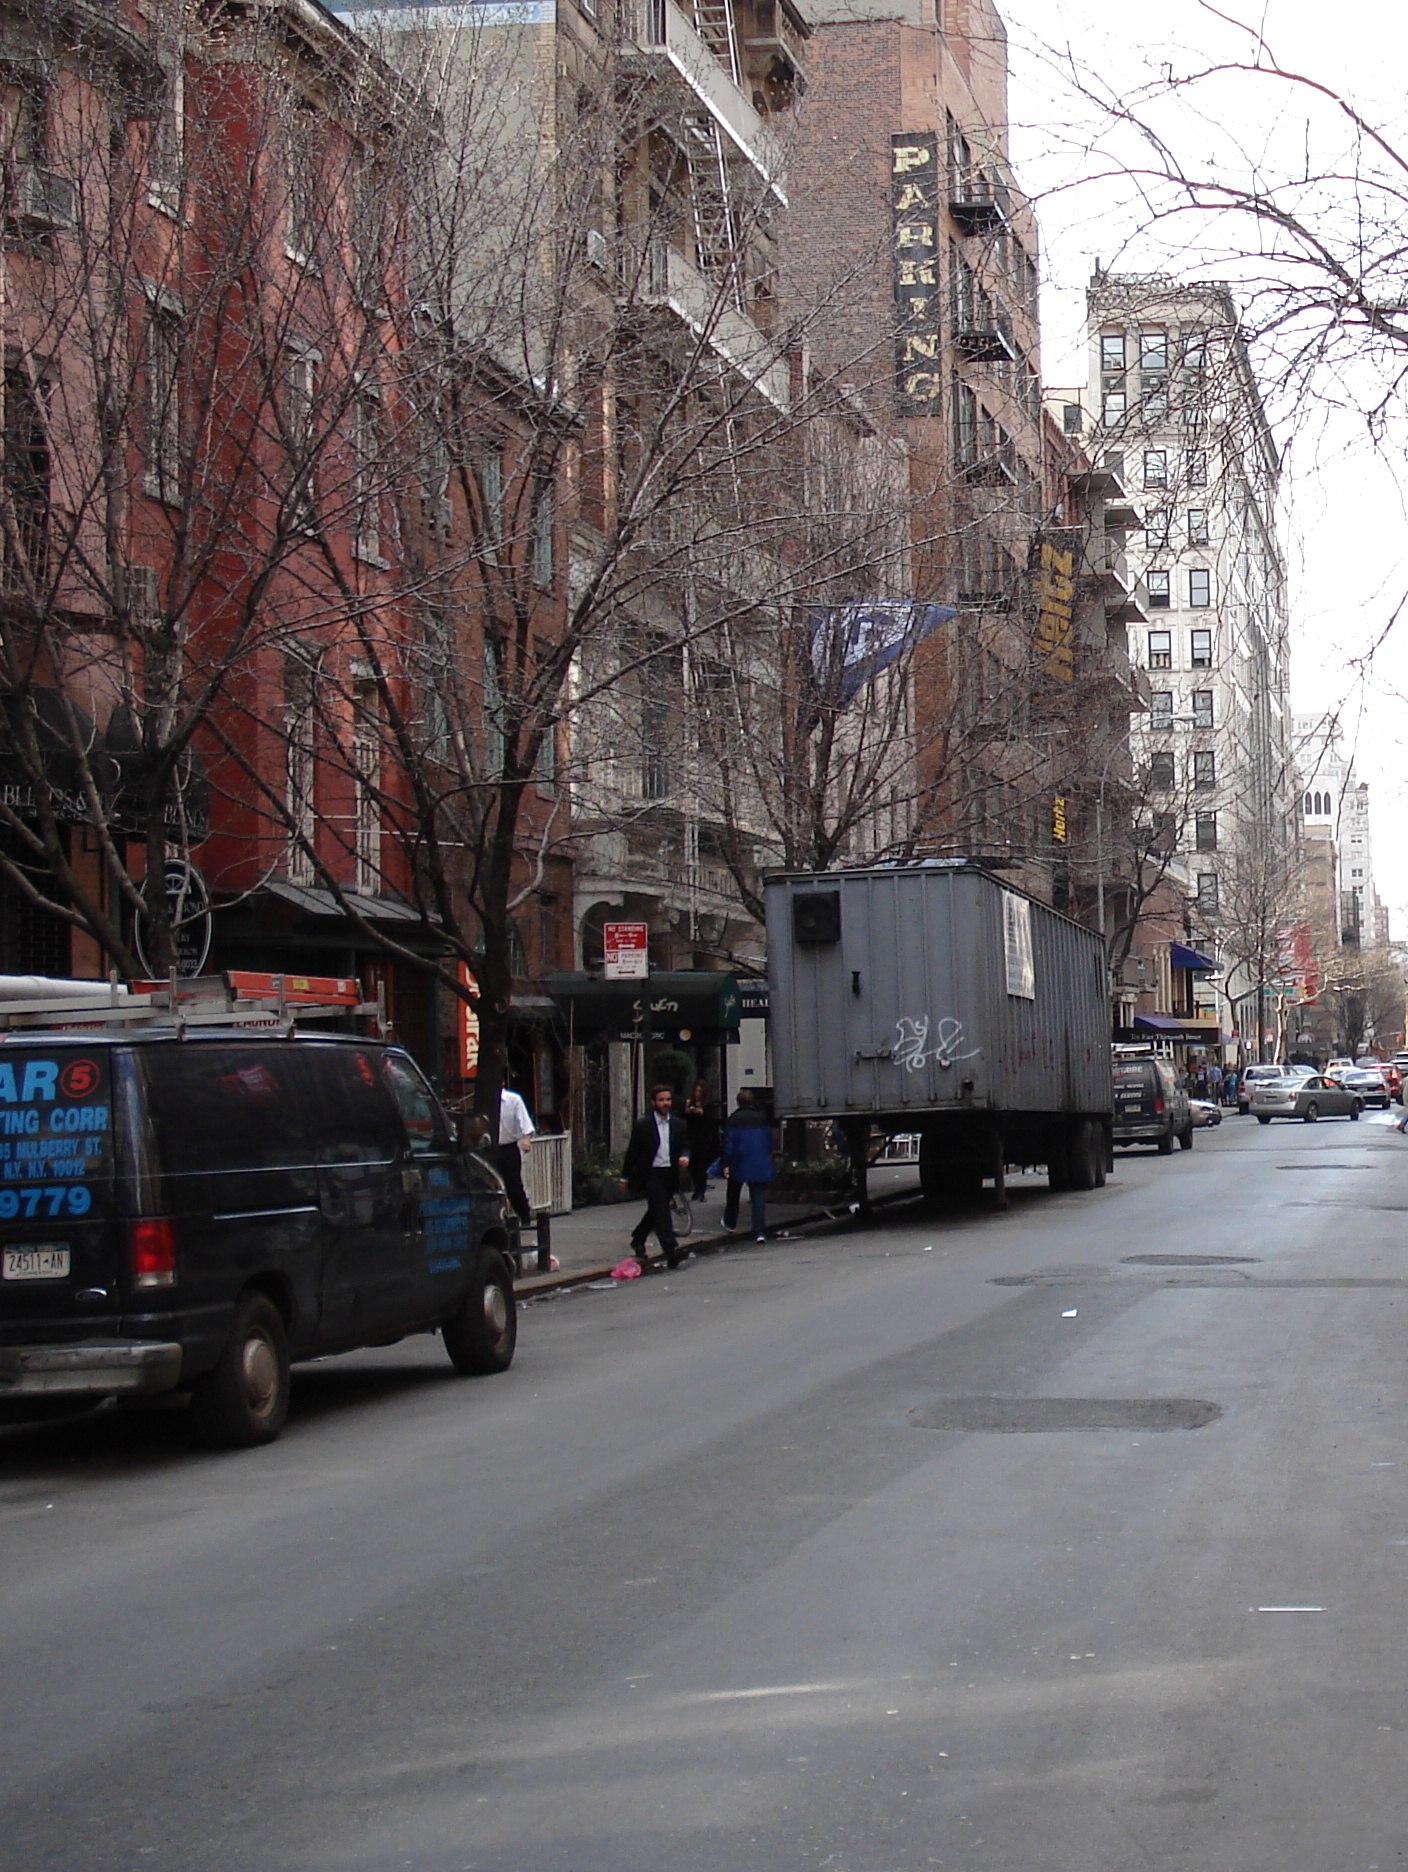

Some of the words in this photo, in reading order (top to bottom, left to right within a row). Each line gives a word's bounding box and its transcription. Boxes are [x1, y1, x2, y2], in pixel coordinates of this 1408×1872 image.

[892, 145, 941, 402] PARKING
[1052, 797, 1066, 842] Hertz
[69, 1065, 92, 1091] 5
[0, 1109, 39, 1136] ING
[16, 1138, 79, 1159] MULBERRY
[53, 1158, 86, 1178] 10012
[0, 1185, 92, 1219] 9779
